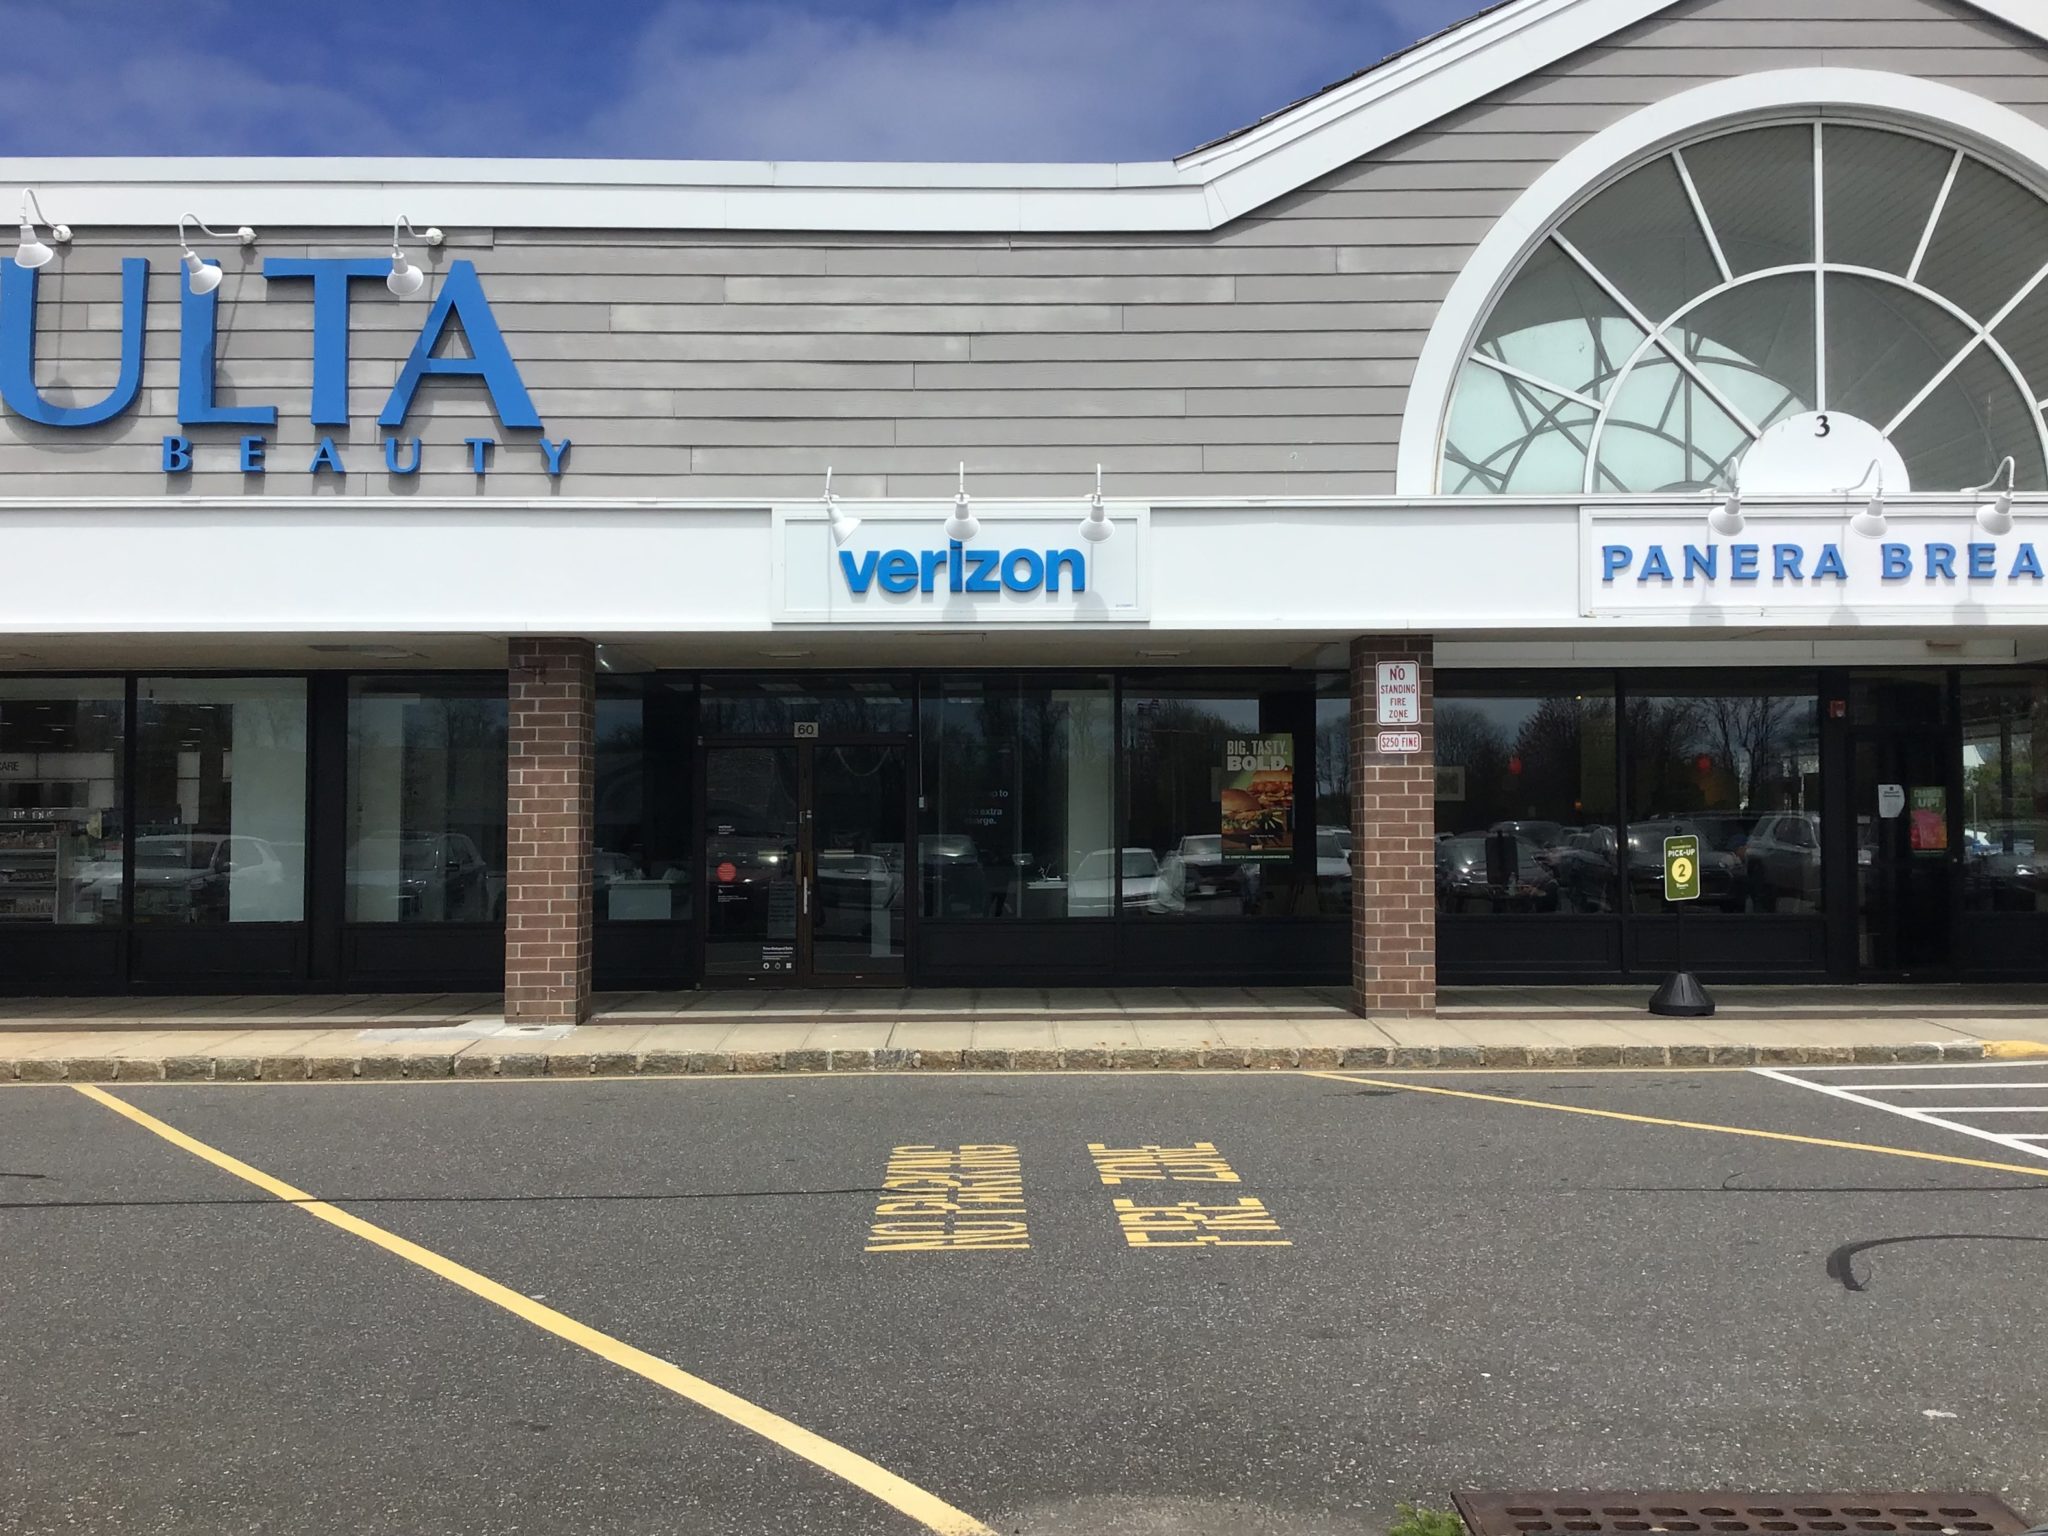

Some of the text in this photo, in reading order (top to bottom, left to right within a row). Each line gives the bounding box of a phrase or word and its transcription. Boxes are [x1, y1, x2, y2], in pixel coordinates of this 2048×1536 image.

[0, 257, 544, 430] ULTA
[1814, 415, 1830, 437] 3
[163, 435, 571, 475] BEAUTY
[839, 539, 1085, 593] verizon
[1602, 542, 2045, 581] PANERA BREA
[1390, 667, 1405, 680] NO
[1380, 684, 1416, 694] STANDING
[1390, 697, 1406, 706] FIRE
[1388, 709, 1408, 719] ZONE
[798, 724, 814, 735] 60
[1227, 740, 1288, 755] BIG. TASTY.
[1381, 736, 1418, 748] $250 FINE
[1227, 755, 1288, 772] BOLD.
[999, 789, 1009, 797] to
[980, 808, 1003, 816] extra
[1667, 848, 1695, 857] PICK-UP
[1678, 863, 1686, 878] 2
[865, 1144, 1031, 1252] NO PARKING
[1086, 1142, 1294, 1248] FIRE ZONE
